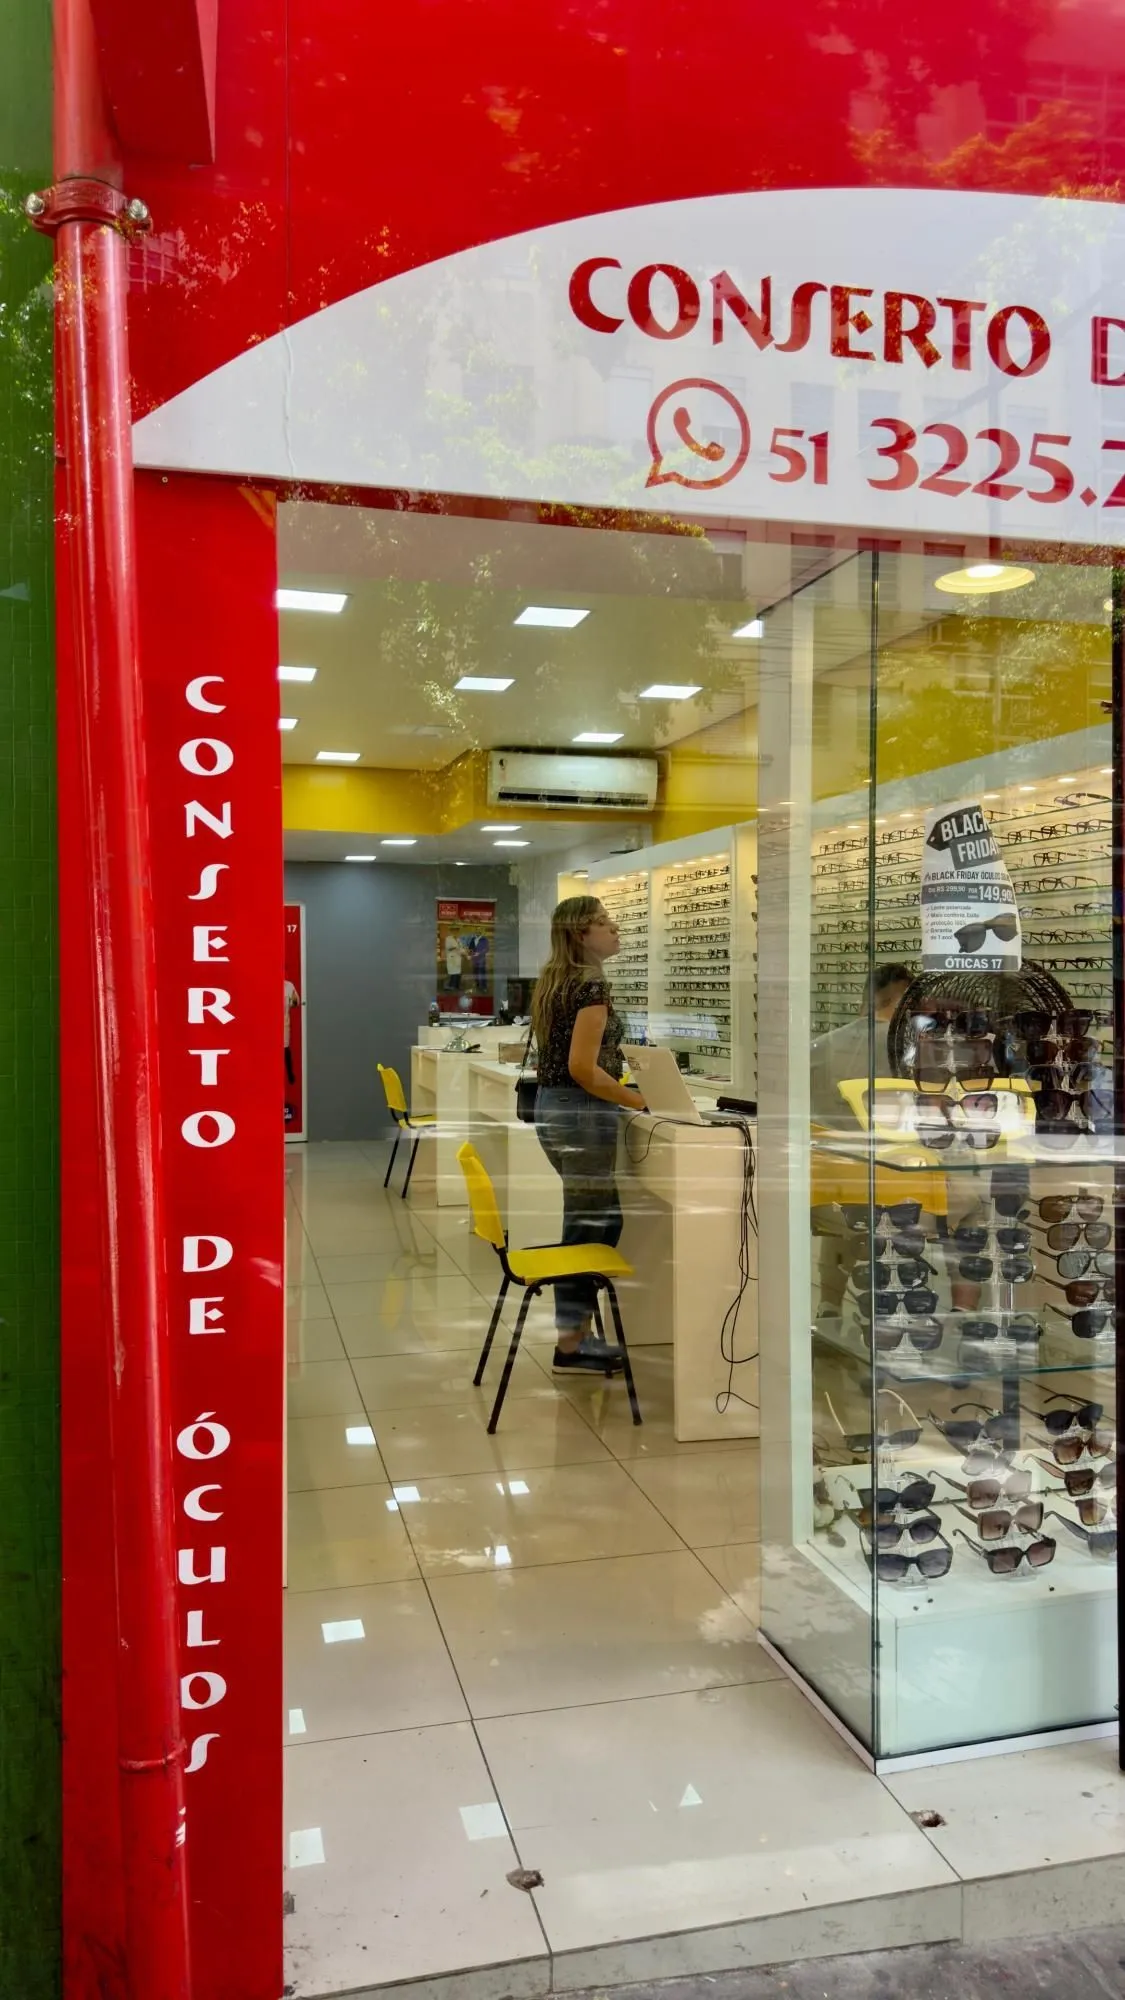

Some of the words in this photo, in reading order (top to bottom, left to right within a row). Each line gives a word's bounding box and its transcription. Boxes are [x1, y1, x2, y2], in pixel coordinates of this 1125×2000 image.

[569, 257, 1051, 377] CONSERTO
[769, 427, 829, 485] 51
[179, 676, 235, 1147] CONSERTO
[931, 871, 955, 881] BLACK
[957, 870, 979, 880] FRIDAY
[287, 924, 297, 933] 17
[945, 956, 988, 969] ÓTICAS
[991, 959, 1003, 969] 17
[183, 1236, 233, 1334] DE
[177, 1411, 230, 1773] ÓCULOS
